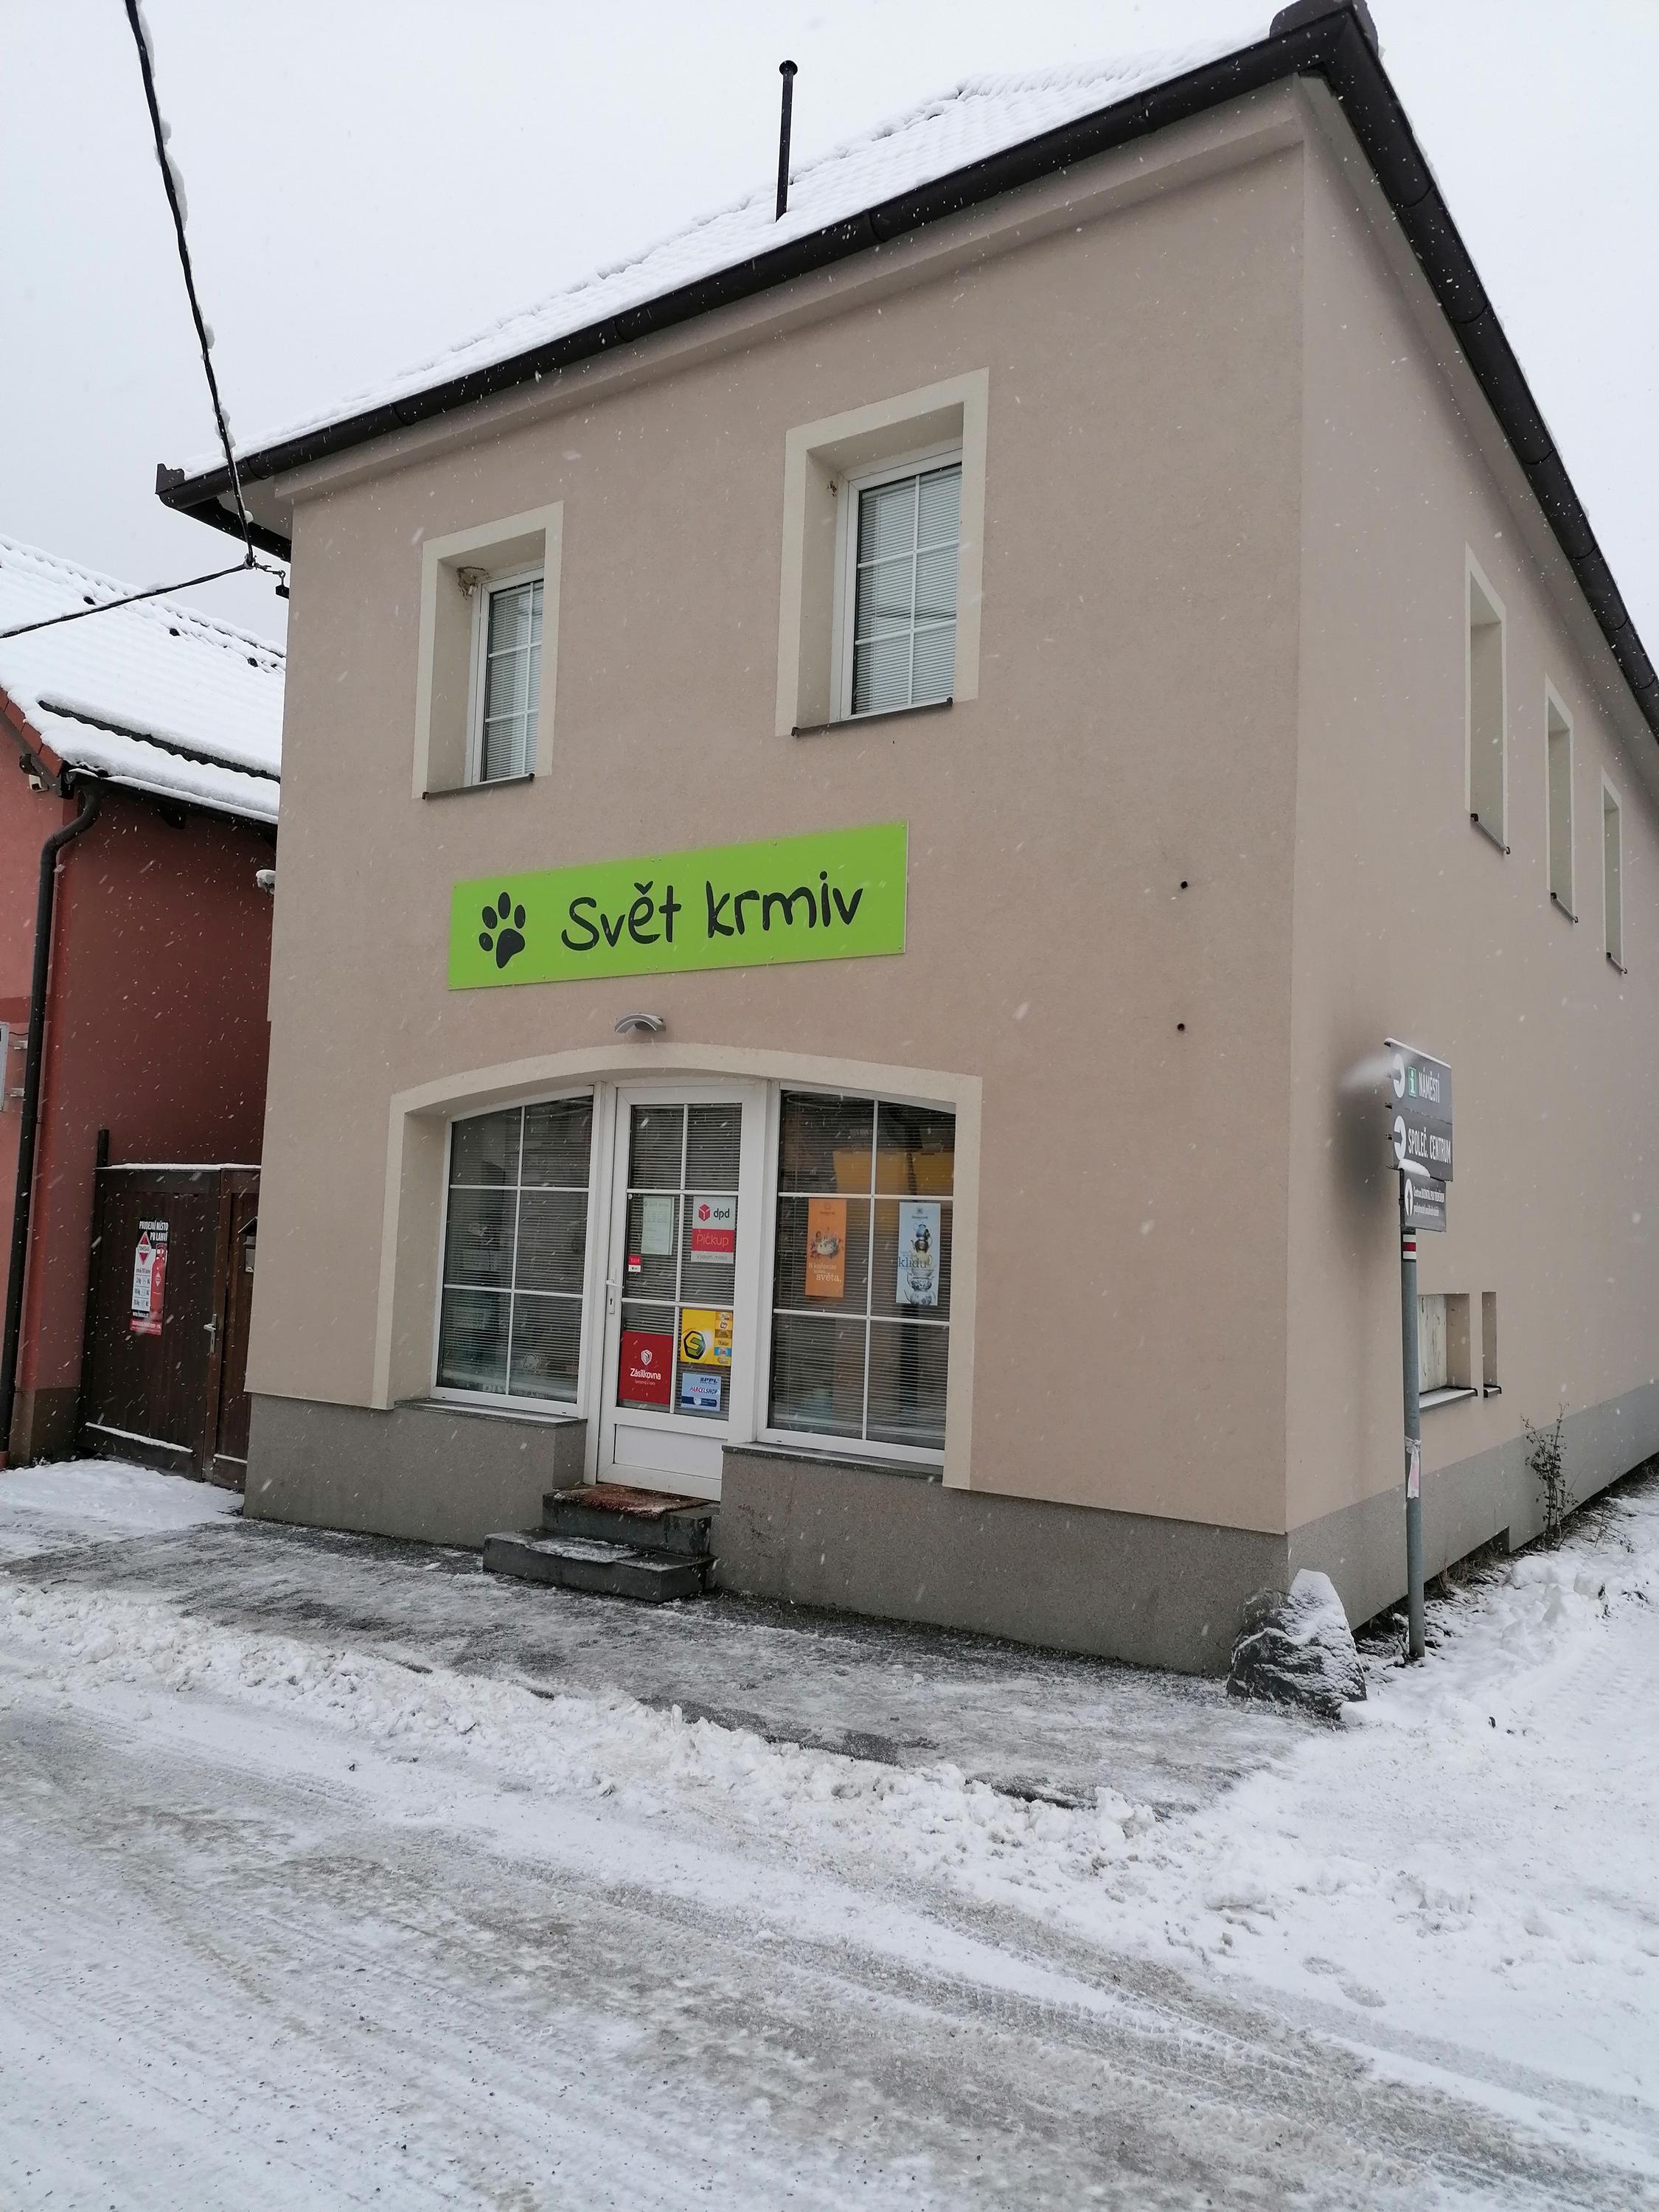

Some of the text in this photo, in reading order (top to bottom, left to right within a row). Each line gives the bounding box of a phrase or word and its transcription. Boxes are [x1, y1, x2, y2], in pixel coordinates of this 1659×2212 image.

[561, 871, 864, 951] Svět krmiv
[1419, 1067, 1440, 1103] NÁMĚSTÍ
[1408, 1127, 1451, 1164] SPOLEČ. CENTRUM
[713, 1208, 730, 1220] dpd
[156, 1220, 169, 1231] MÍSTO
[696, 1234, 729, 1248] Pickup
[897, 1256, 928, 1269] klidu
[815, 1272, 842, 1283] světa.
[630, 1368, 661, 1380] Zásilkovna
[689, 1386, 718, 1394] PARCELSHOP
